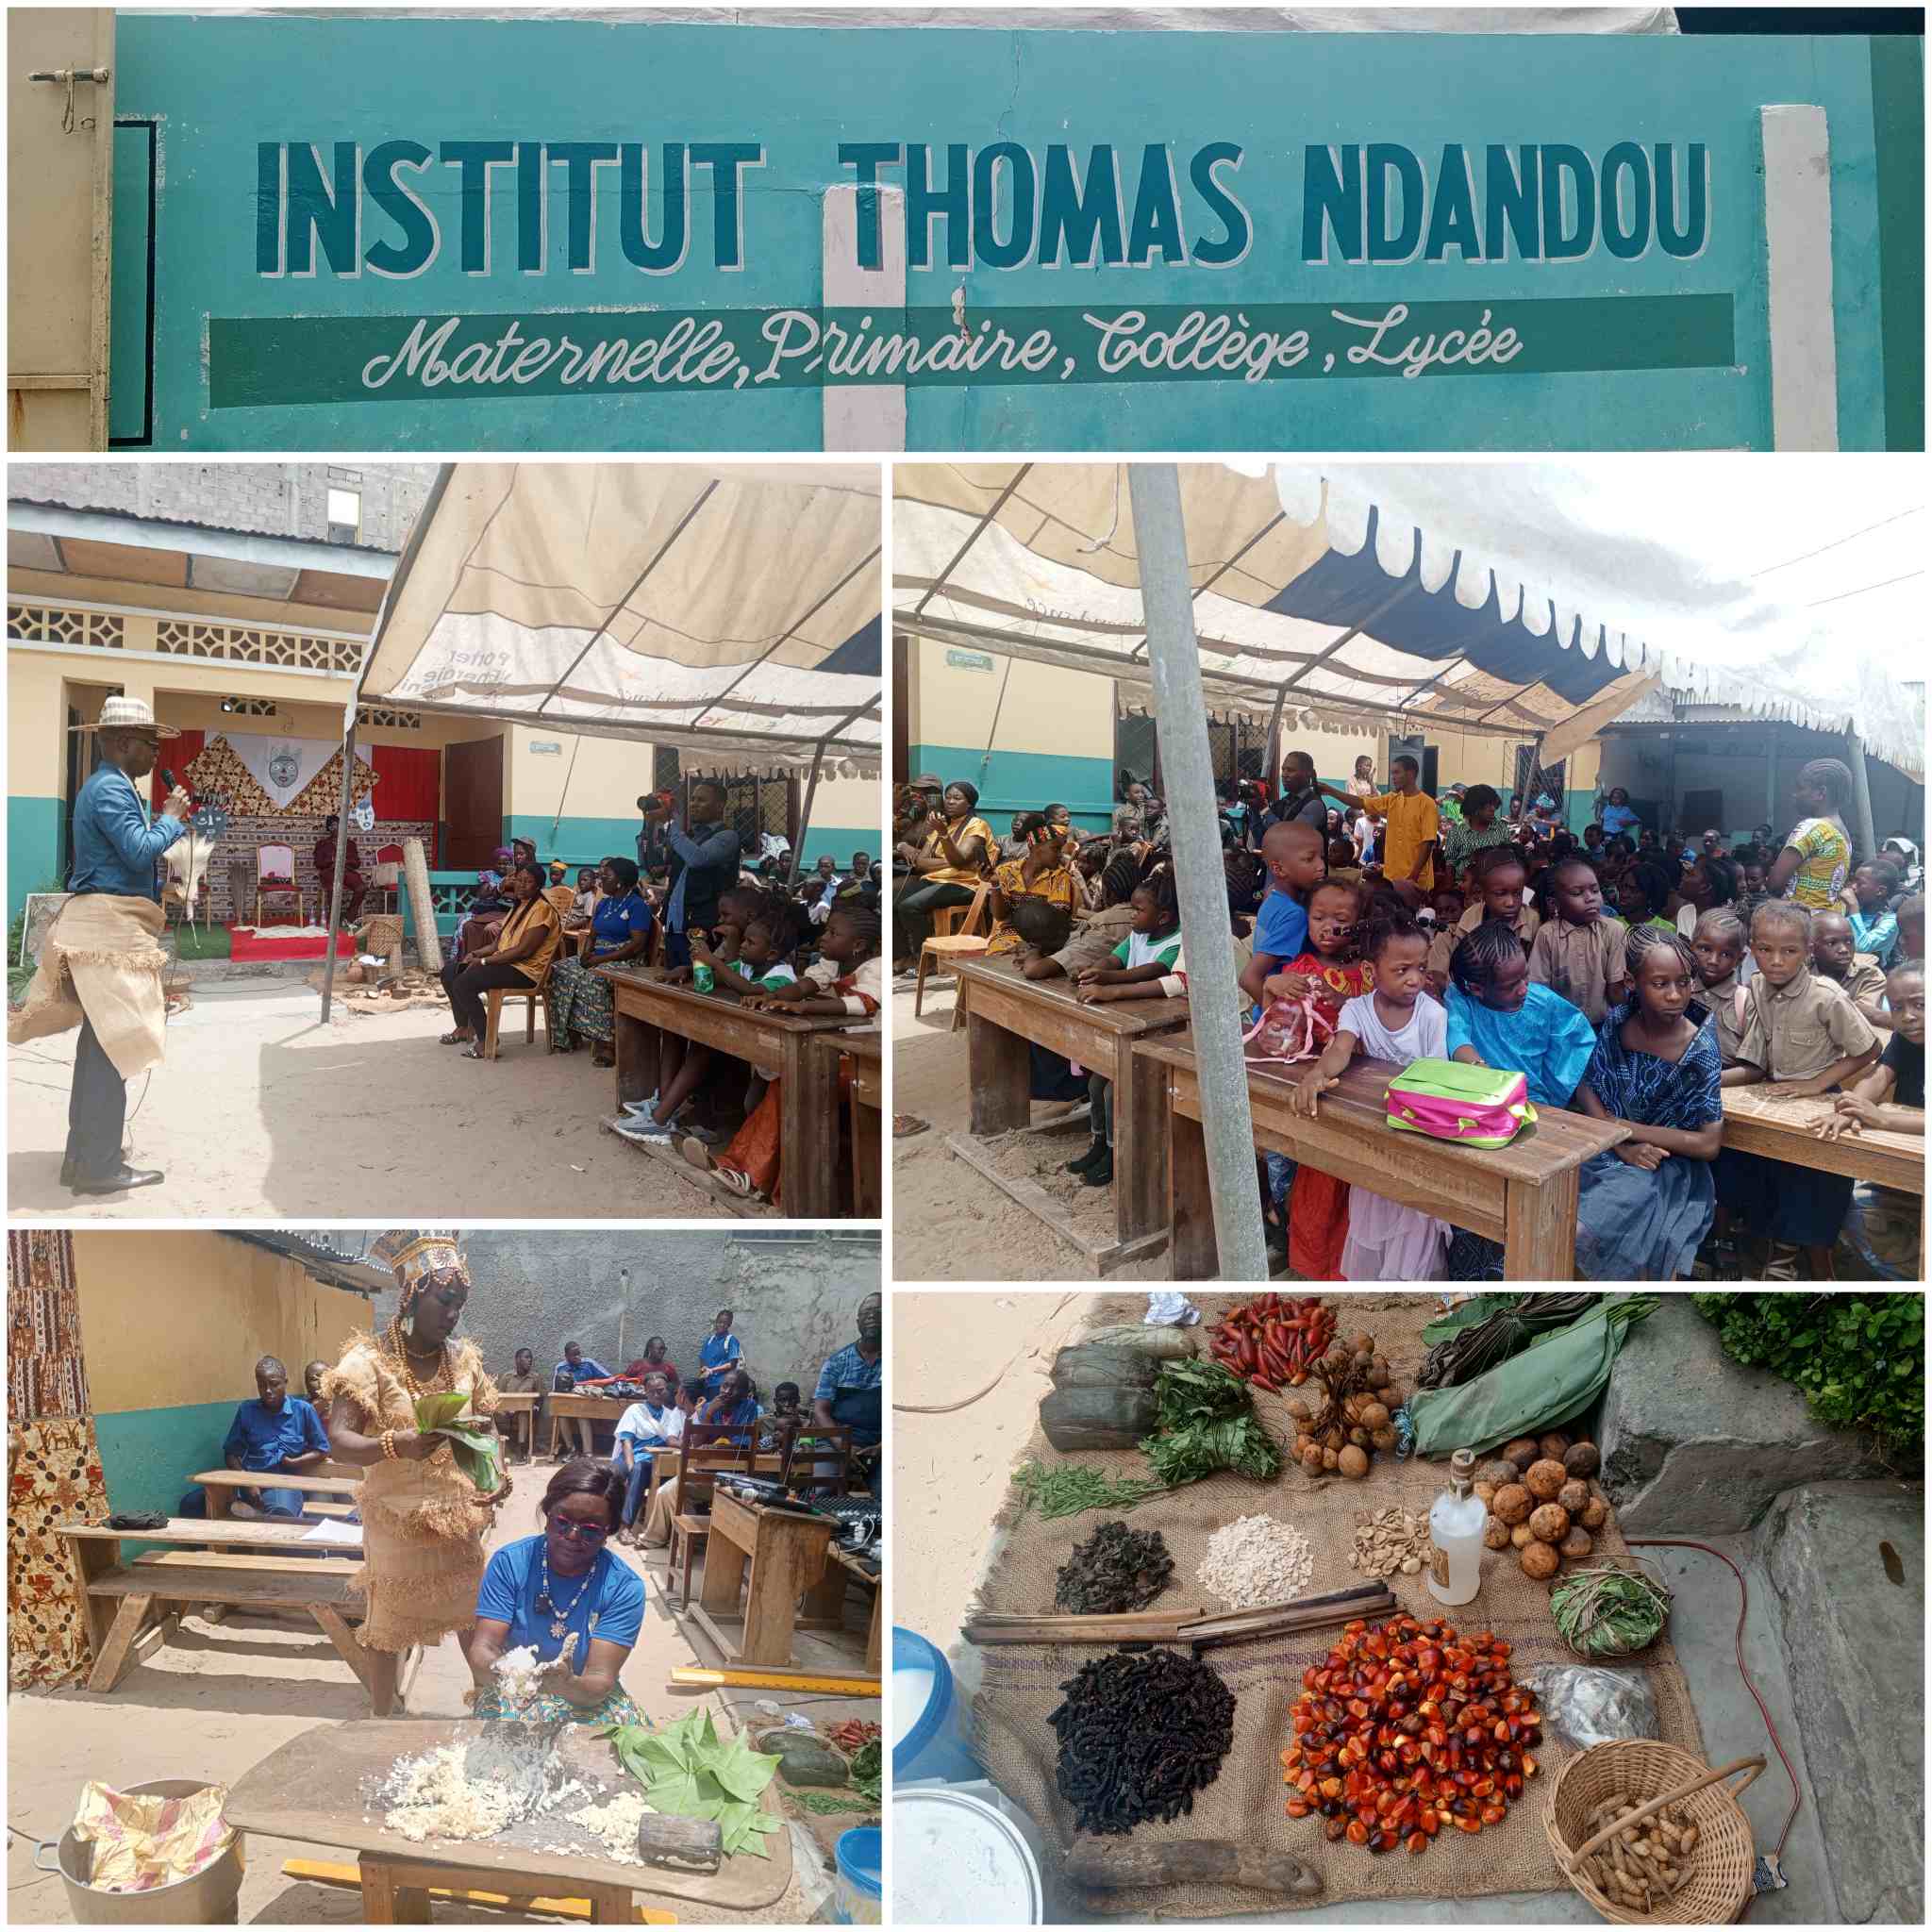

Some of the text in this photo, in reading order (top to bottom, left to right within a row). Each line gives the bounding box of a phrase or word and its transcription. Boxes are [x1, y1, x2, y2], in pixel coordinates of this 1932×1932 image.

[256, 141, 1713, 279] INSTITUT THOMAS NDANDOU
[362, 316, 749, 391] Maternelle,
[754, 309, 1075, 384] Primaire,
[1331, 303, 1524, 379] Lycée
